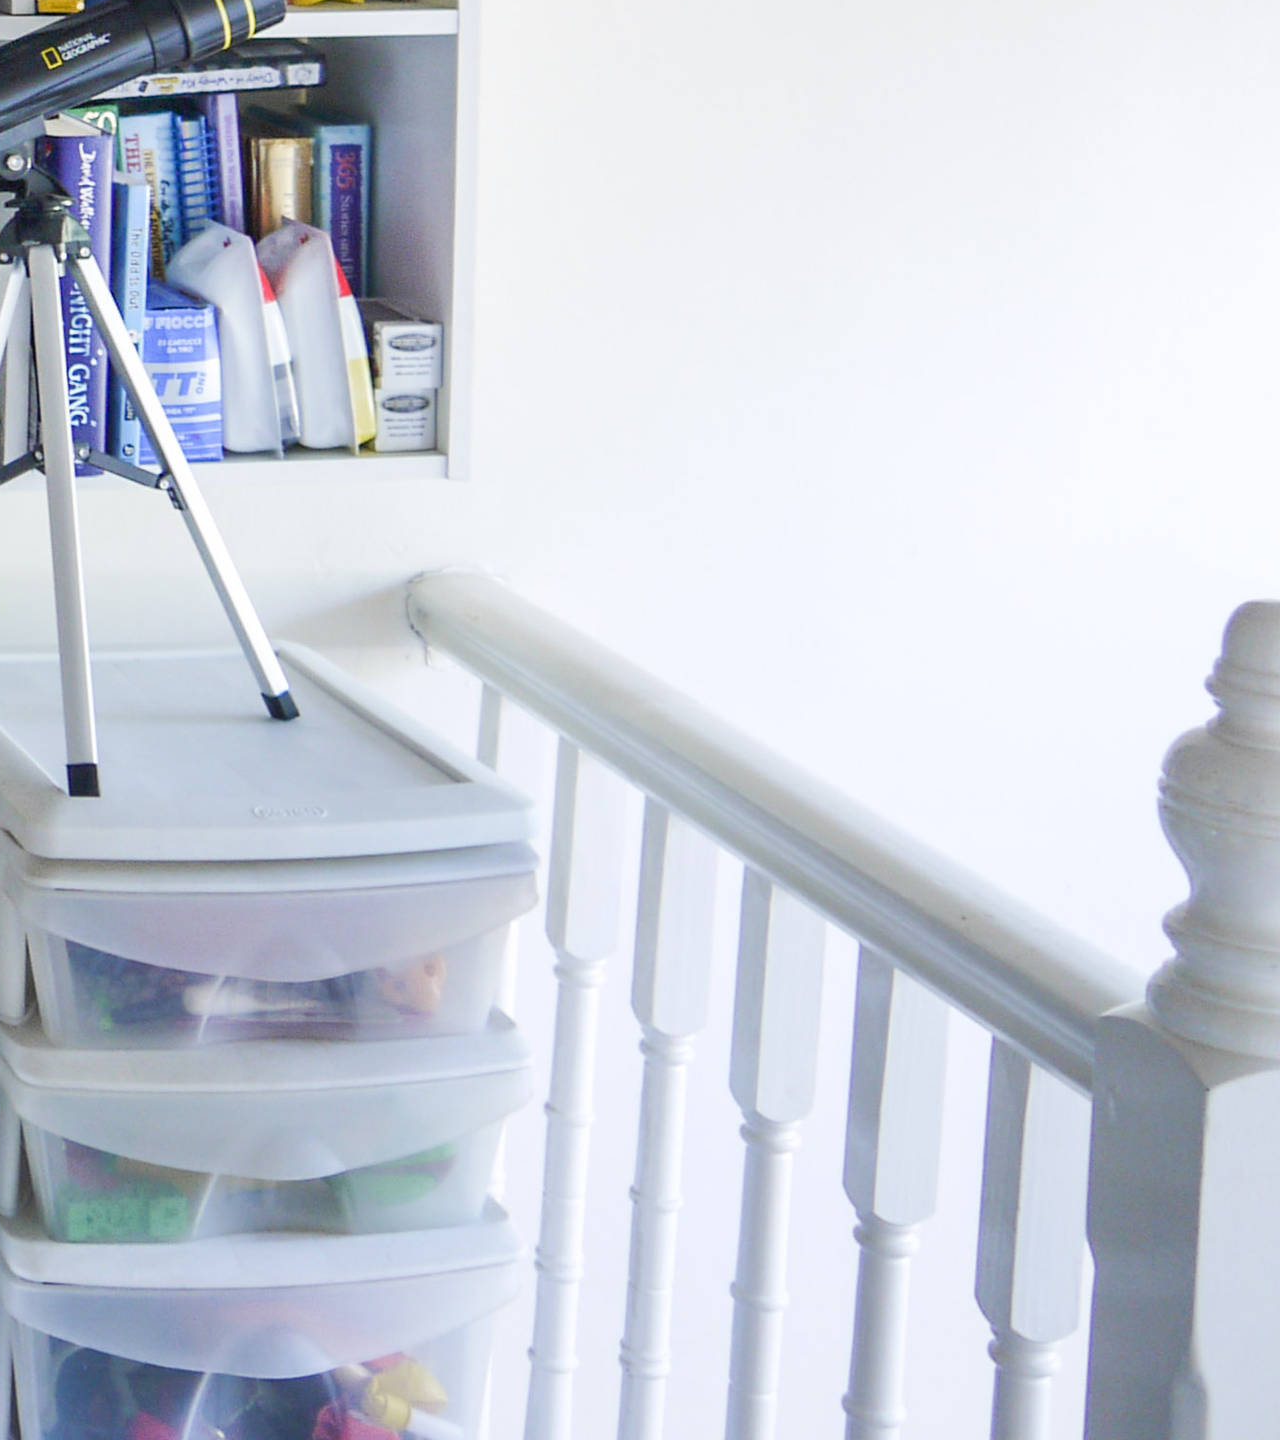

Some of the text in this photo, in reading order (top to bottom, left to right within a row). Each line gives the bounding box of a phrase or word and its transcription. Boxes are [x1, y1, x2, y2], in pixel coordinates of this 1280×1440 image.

[57, 32, 97, 51] NATIONAL
[61, 33, 112, 61] GEOGRAPHIC
[79, 141, 96, 187] David
[125, 133, 142, 174] THE
[336, 151, 359, 190] 365
[131, 227, 143, 247] The
[129, 290, 140, 310] Out
[67, 281, 94, 428] NIGHT GANG
